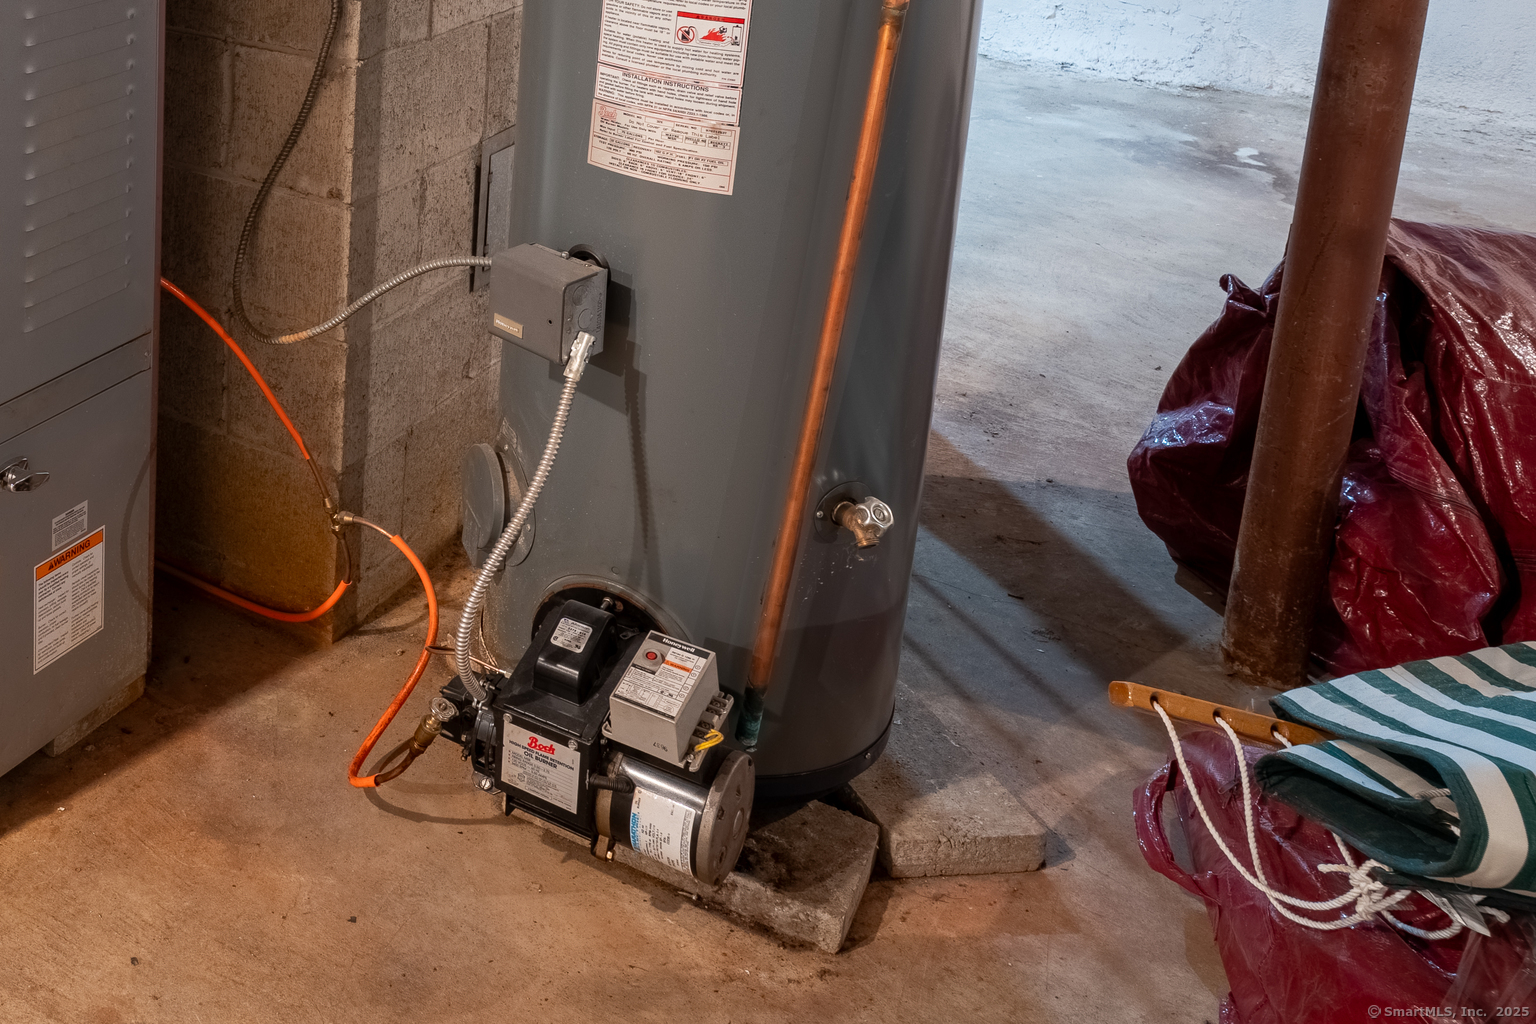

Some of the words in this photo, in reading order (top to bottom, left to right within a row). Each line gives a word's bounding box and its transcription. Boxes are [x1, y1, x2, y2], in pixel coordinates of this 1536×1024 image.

[622, 71, 662, 84] INSTALLATION
[663, 80, 709, 92] INSTRUCTIONS
[54, 539, 91, 567] WARNING
[662, 637, 696, 653] Honeywell
[508, 739, 521, 748] HIGH
[522, 744, 535, 754] SPEED
[535, 750, 550, 760] FLAME
[549, 756, 575, 771] RETENTION
[527, 736, 556, 755] Bock
[523, 751, 534, 759] OIL
[534, 755, 558, 769] BURNER
